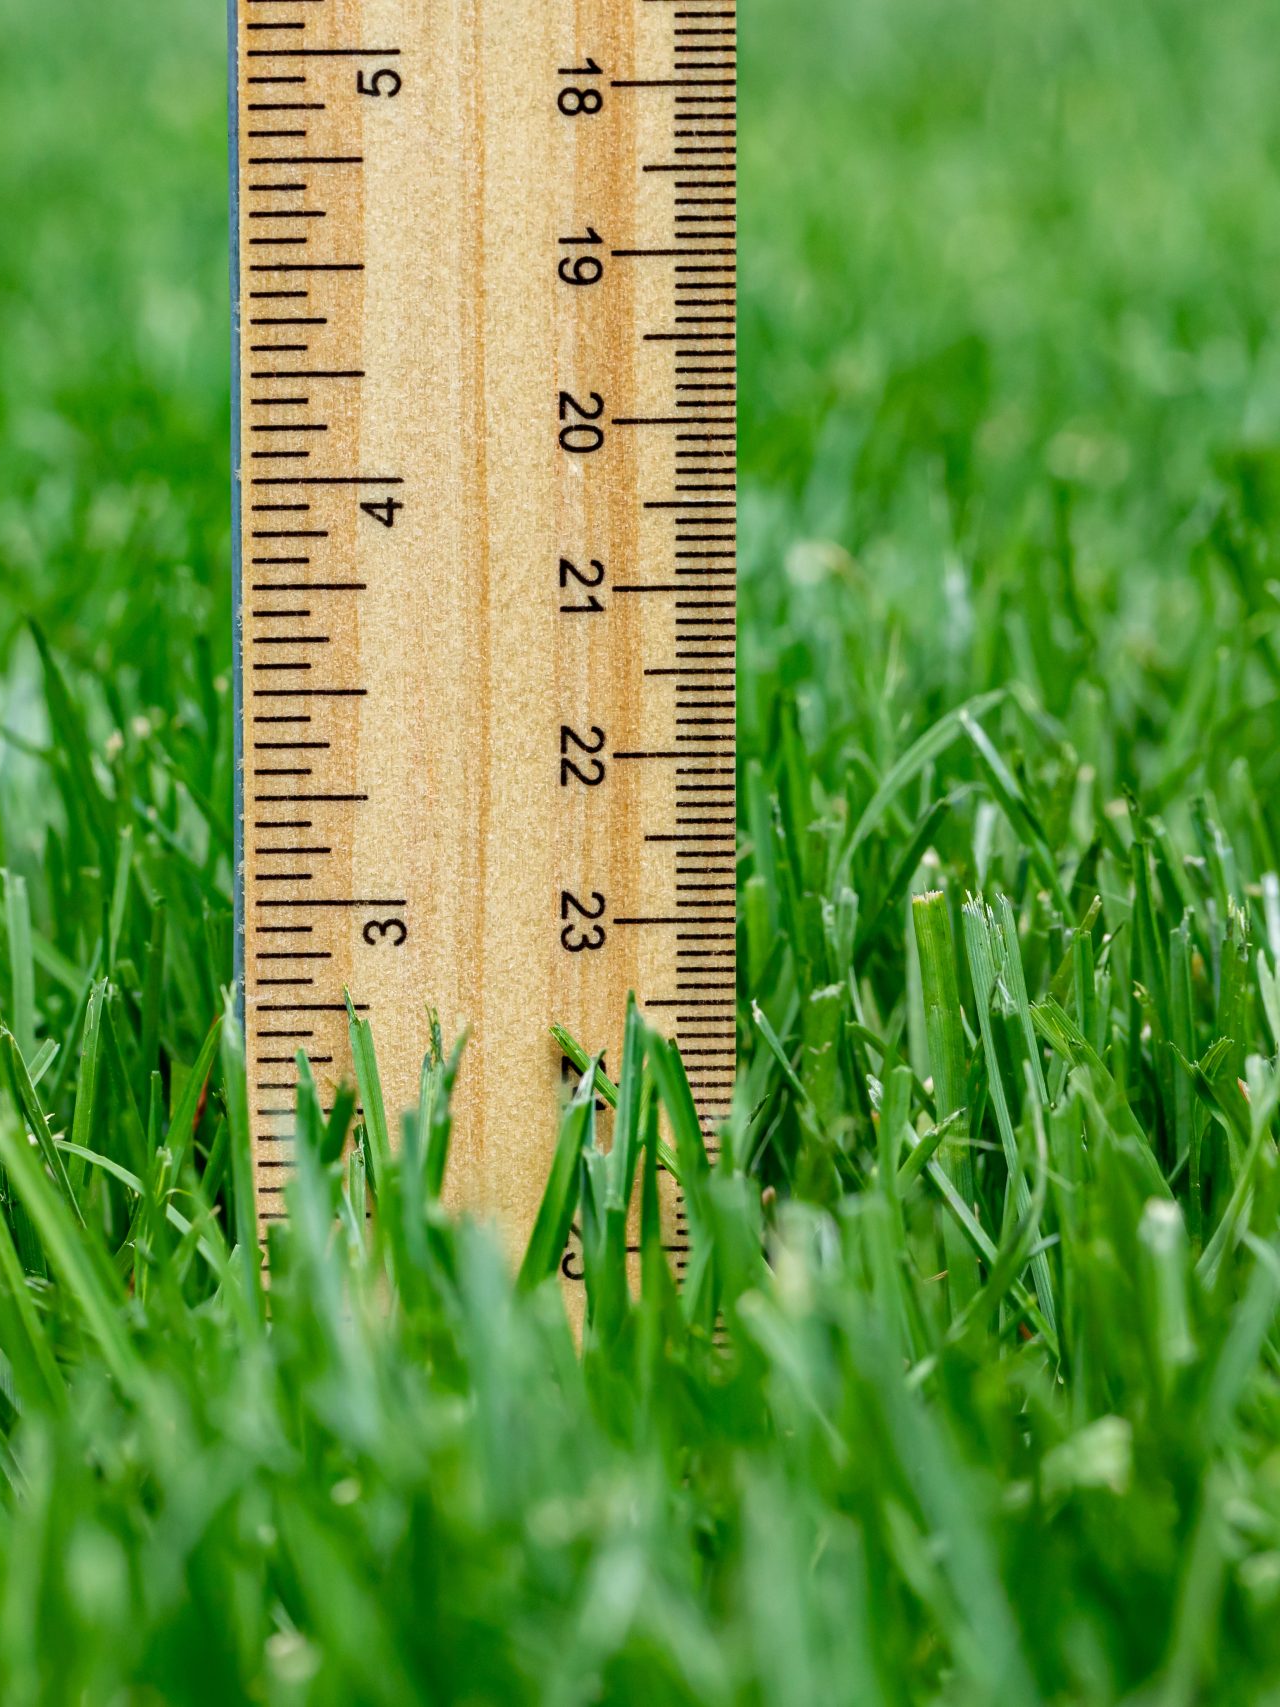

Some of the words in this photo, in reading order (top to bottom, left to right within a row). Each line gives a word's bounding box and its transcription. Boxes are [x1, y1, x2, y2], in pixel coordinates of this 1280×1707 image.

[356, 68, 402, 98] 5
[557, 57, 604, 117] 18
[557, 226, 604, 286] 19
[558, 391, 605, 454] 20
[359, 496, 404, 529] 4
[559, 557, 605, 614] 21
[560, 725, 606, 787] 22
[362, 918, 408, 947] 3
[560, 890, 607, 953] 23
